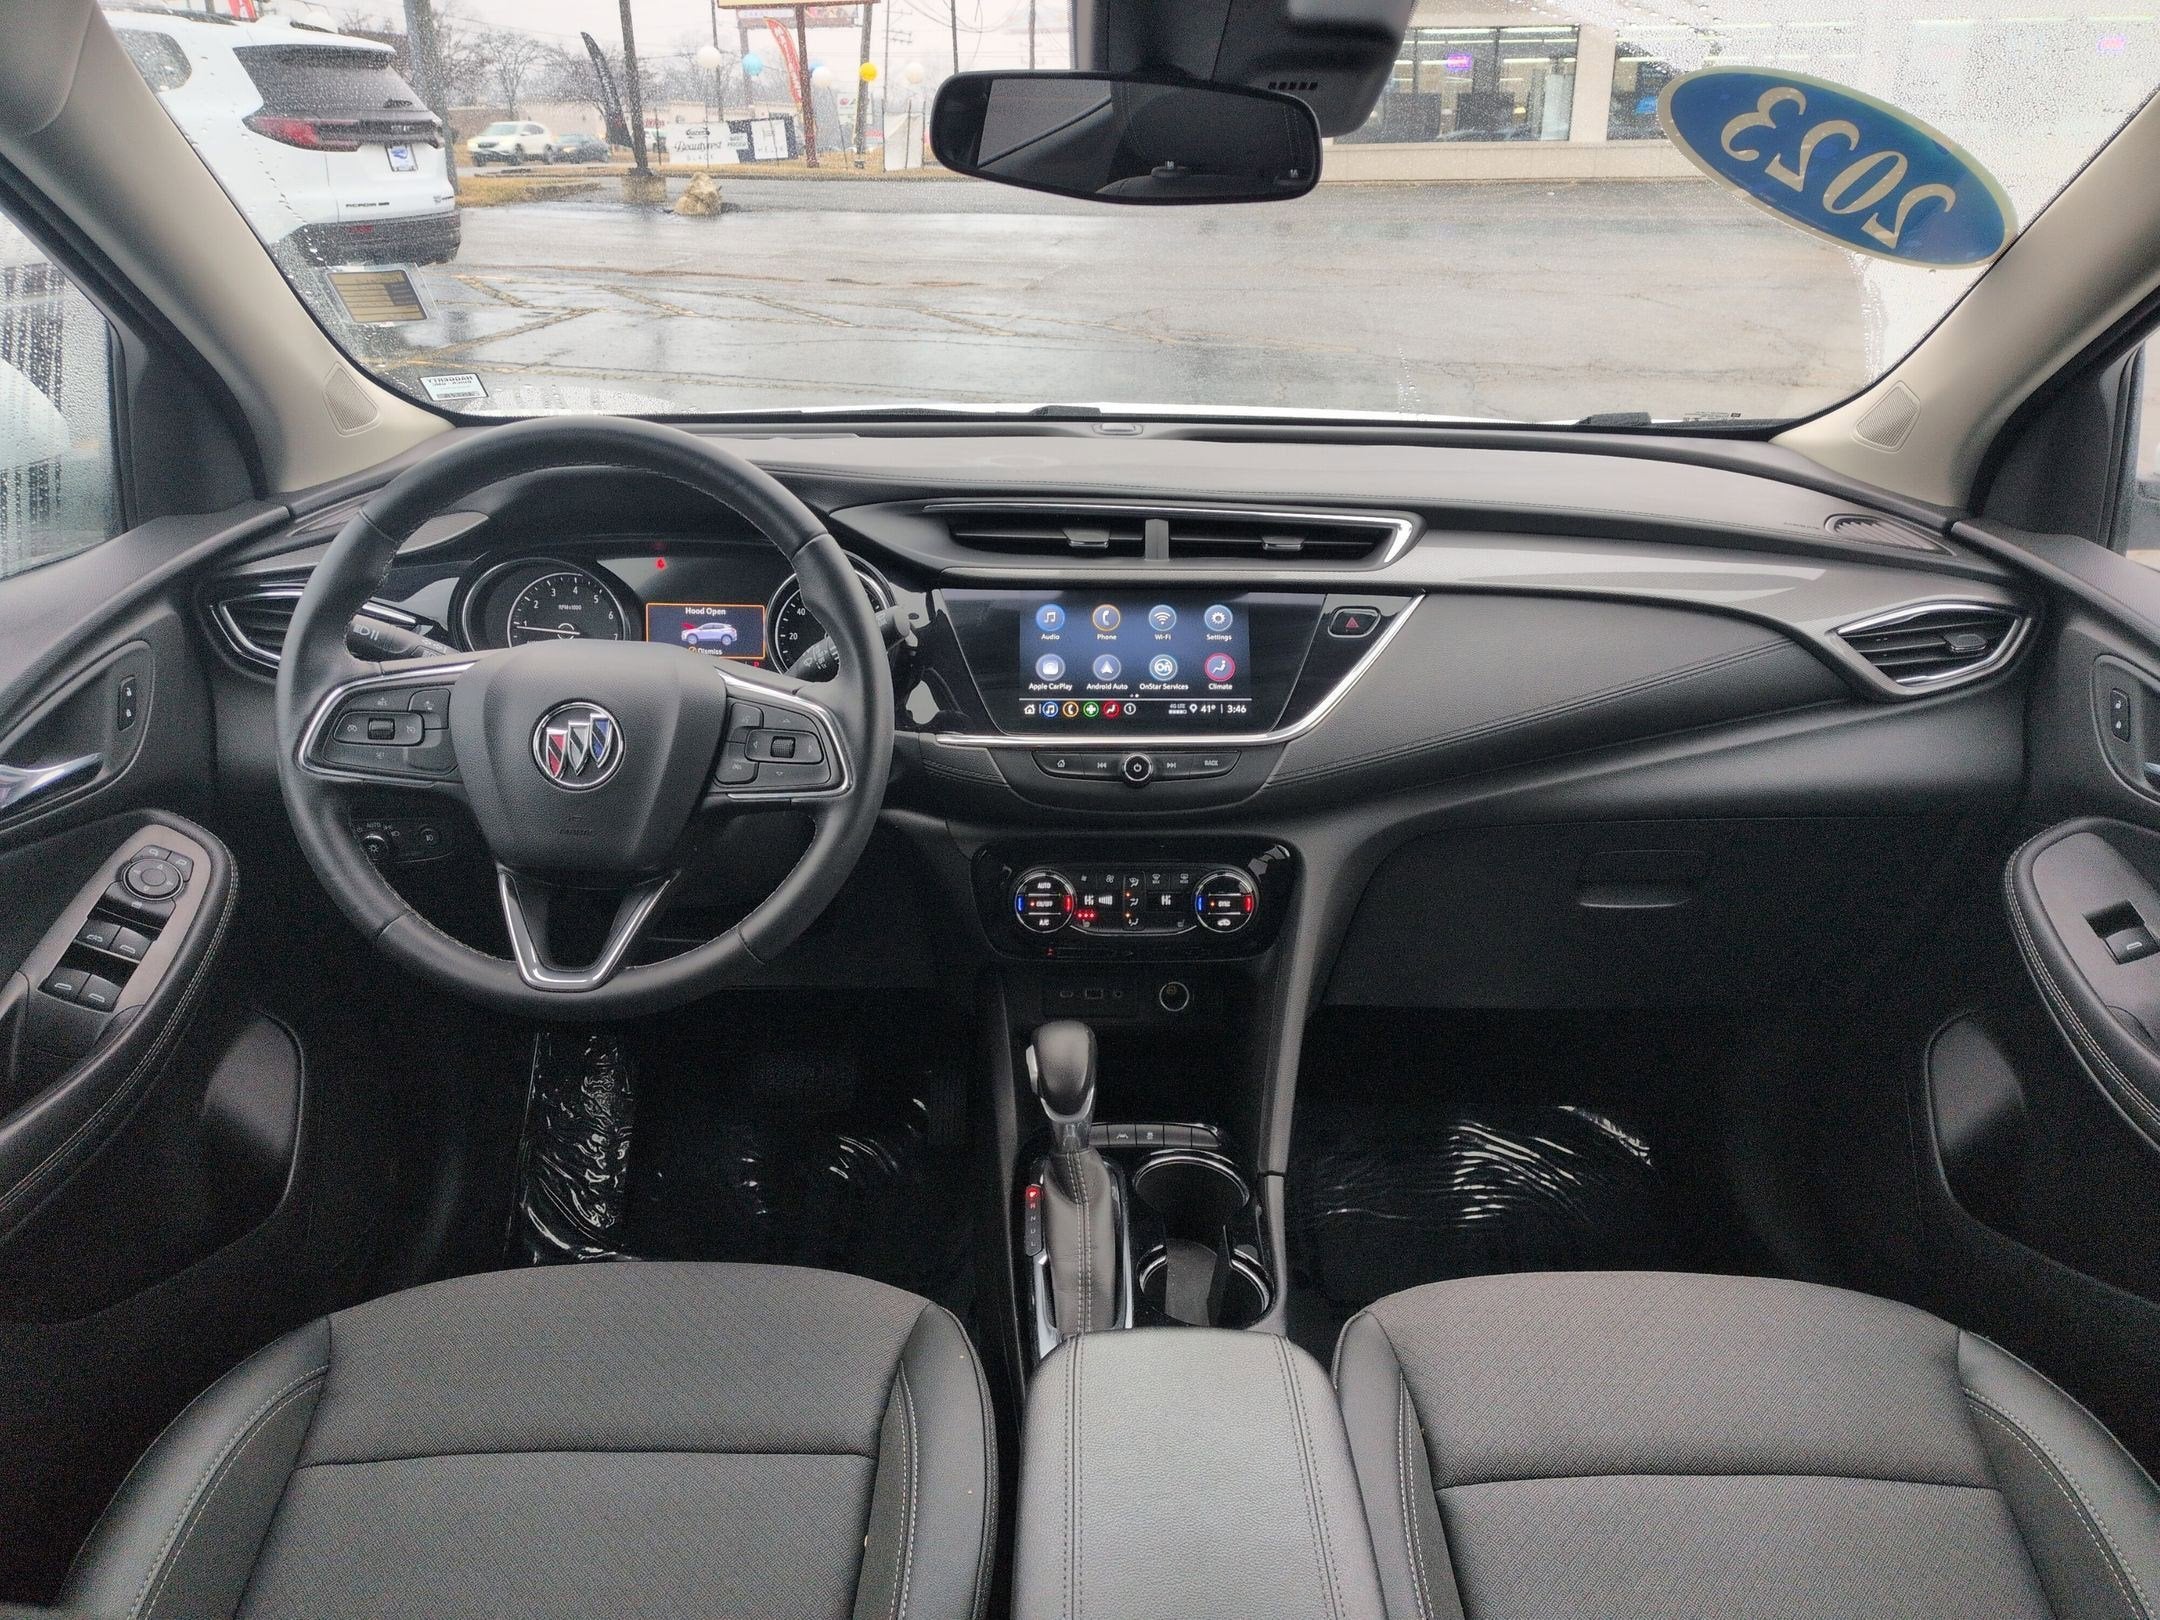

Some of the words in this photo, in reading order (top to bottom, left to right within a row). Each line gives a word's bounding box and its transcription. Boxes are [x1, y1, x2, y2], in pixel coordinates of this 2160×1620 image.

[551, 588, 556, 597] 3
[573, 586, 578, 595] 4
[593, 594, 599, 604] 5
[533, 600, 539, 609] 2
[608, 610, 614, 620] 6
[685, 607, 705, 615] Hood
[706, 607, 726, 617] Open
[796, 608, 806, 616] 40
[789, 632, 798, 641] 20
[1041, 633, 1060, 641] Audio
[1097, 633, 1117, 641] Phone
[1154, 633, 1172, 641] Wi-Fi
[1206, 633, 1232, 642] Settings
[697, 647, 723, 656] Dismiss
[1028, 682, 1048, 691] Apple
[1048, 682, 1073, 691] CarPlay
[1086, 682, 1112, 691] Android
[1112, 682, 1129, 691] Auto
[1139, 683, 1162, 691] OnStar
[1162, 683, 1190, 691] Services
[1208, 683, 1233, 691] Climate
[1227, 704, 1248, 714] 3:46
